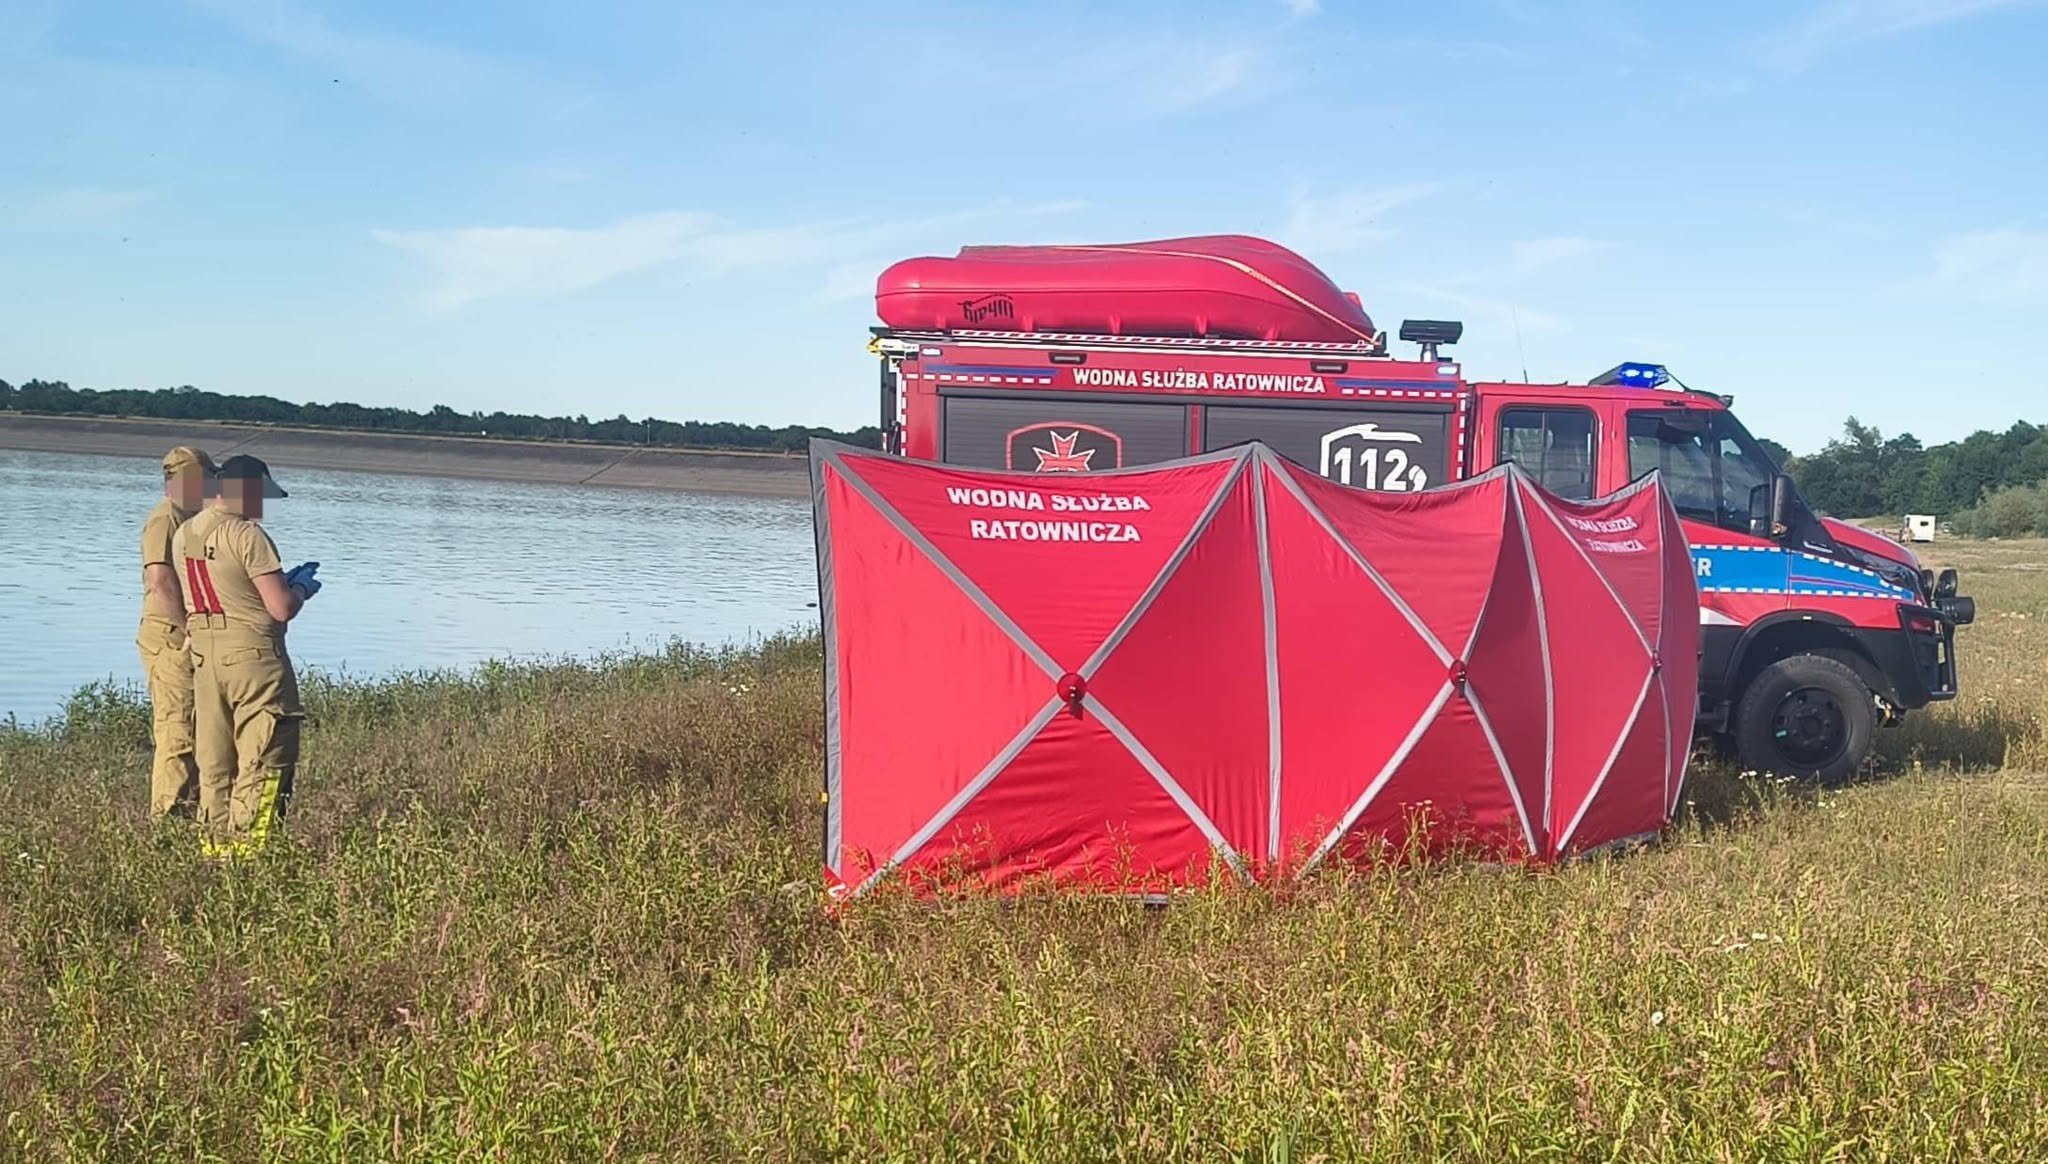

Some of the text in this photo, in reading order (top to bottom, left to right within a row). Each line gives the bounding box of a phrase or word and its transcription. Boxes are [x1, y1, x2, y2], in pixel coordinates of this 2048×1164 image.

[1073, 368, 1326, 393] WODNA SŁUŻBA RATOWNICZA
[1334, 447, 1407, 491] 112
[947, 487, 1151, 542] WODNA SŁUŻBA RATOWNICZA
